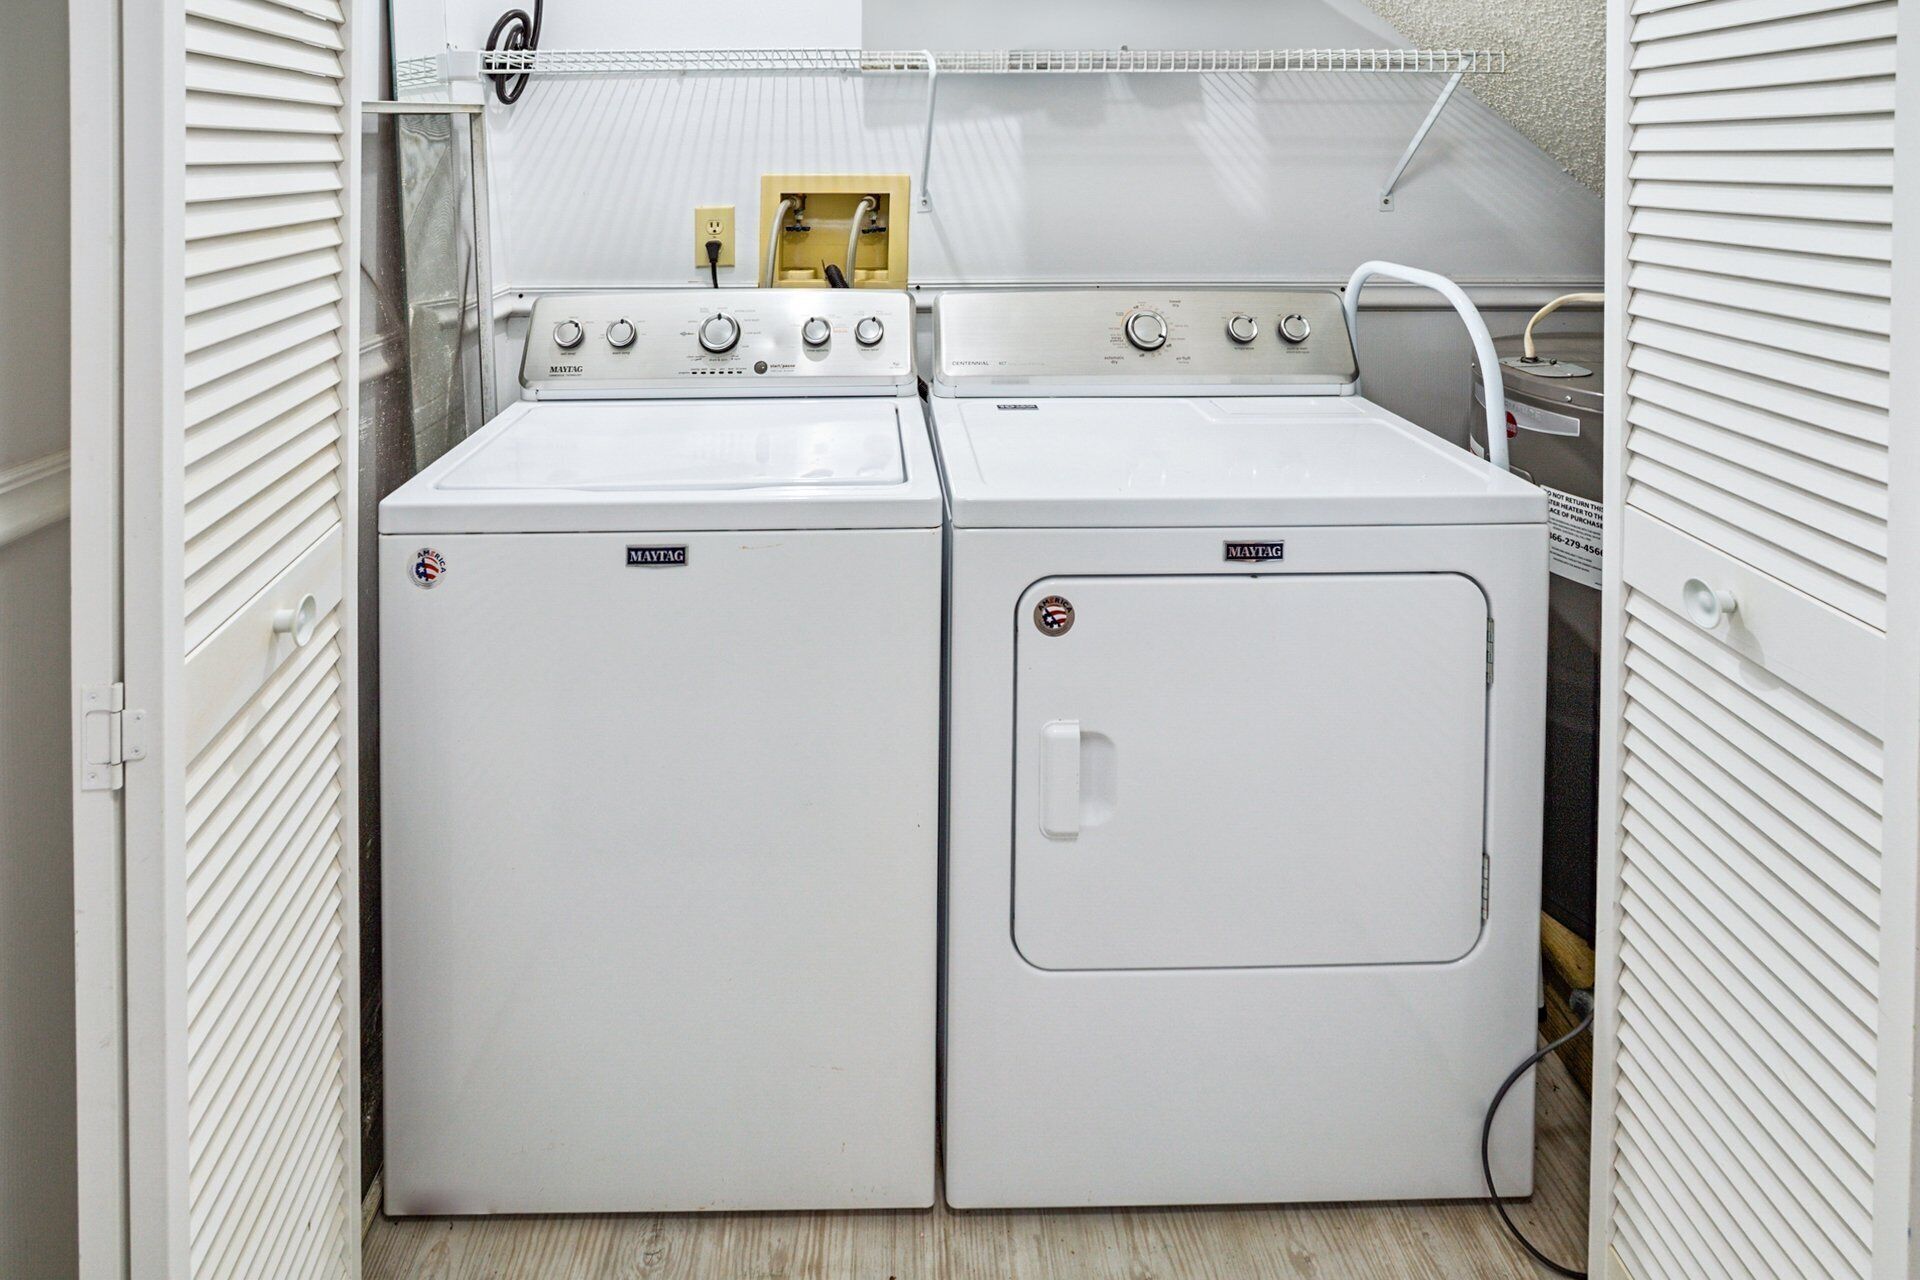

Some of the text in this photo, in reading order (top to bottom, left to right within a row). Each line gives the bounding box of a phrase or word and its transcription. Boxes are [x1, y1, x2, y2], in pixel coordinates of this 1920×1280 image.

[549, 365, 583, 373] MAYTAG
[1552, 492, 1564, 500] NOT
[1565, 496, 1590, 509] RETURN
[1549, 507, 1561, 516] ACE
[1570, 513, 1603, 529] PURCHASE
[1560, 502, 1583, 514] HEATER
[1584, 510, 1593, 518] TO
[1593, 512, 1603, 521] TH
[629, 550, 684, 562] MAYTAG
[1228, 546, 1281, 557] MAYTAG
[417, 550, 446, 573] AMERICA
[1038, 597, 1072, 613] AMERICA
